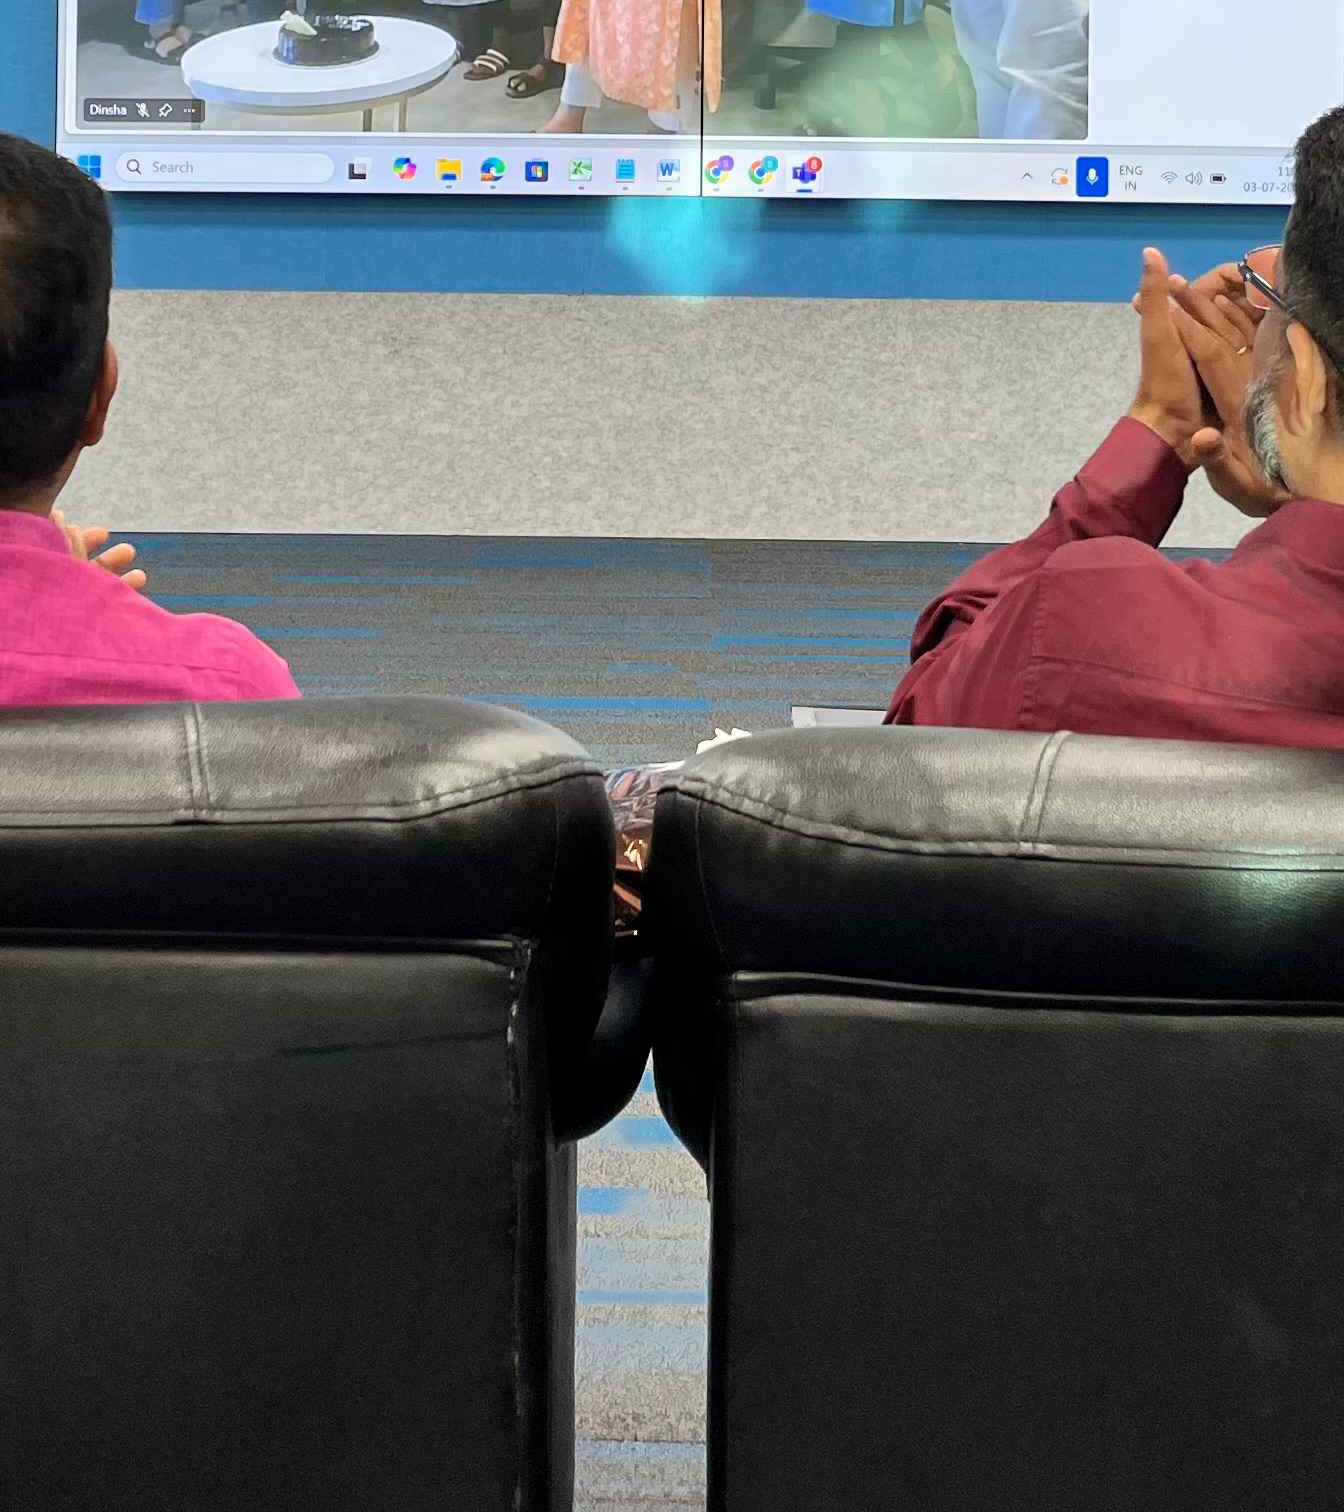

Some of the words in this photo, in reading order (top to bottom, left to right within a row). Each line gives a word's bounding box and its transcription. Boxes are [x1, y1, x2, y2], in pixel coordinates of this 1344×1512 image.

[89, 104, 128, 116] Dinsha
[152, 162, 194, 174] Search
[1119, 165, 1143, 176] ENG
[1124, 182, 1137, 191] IN
